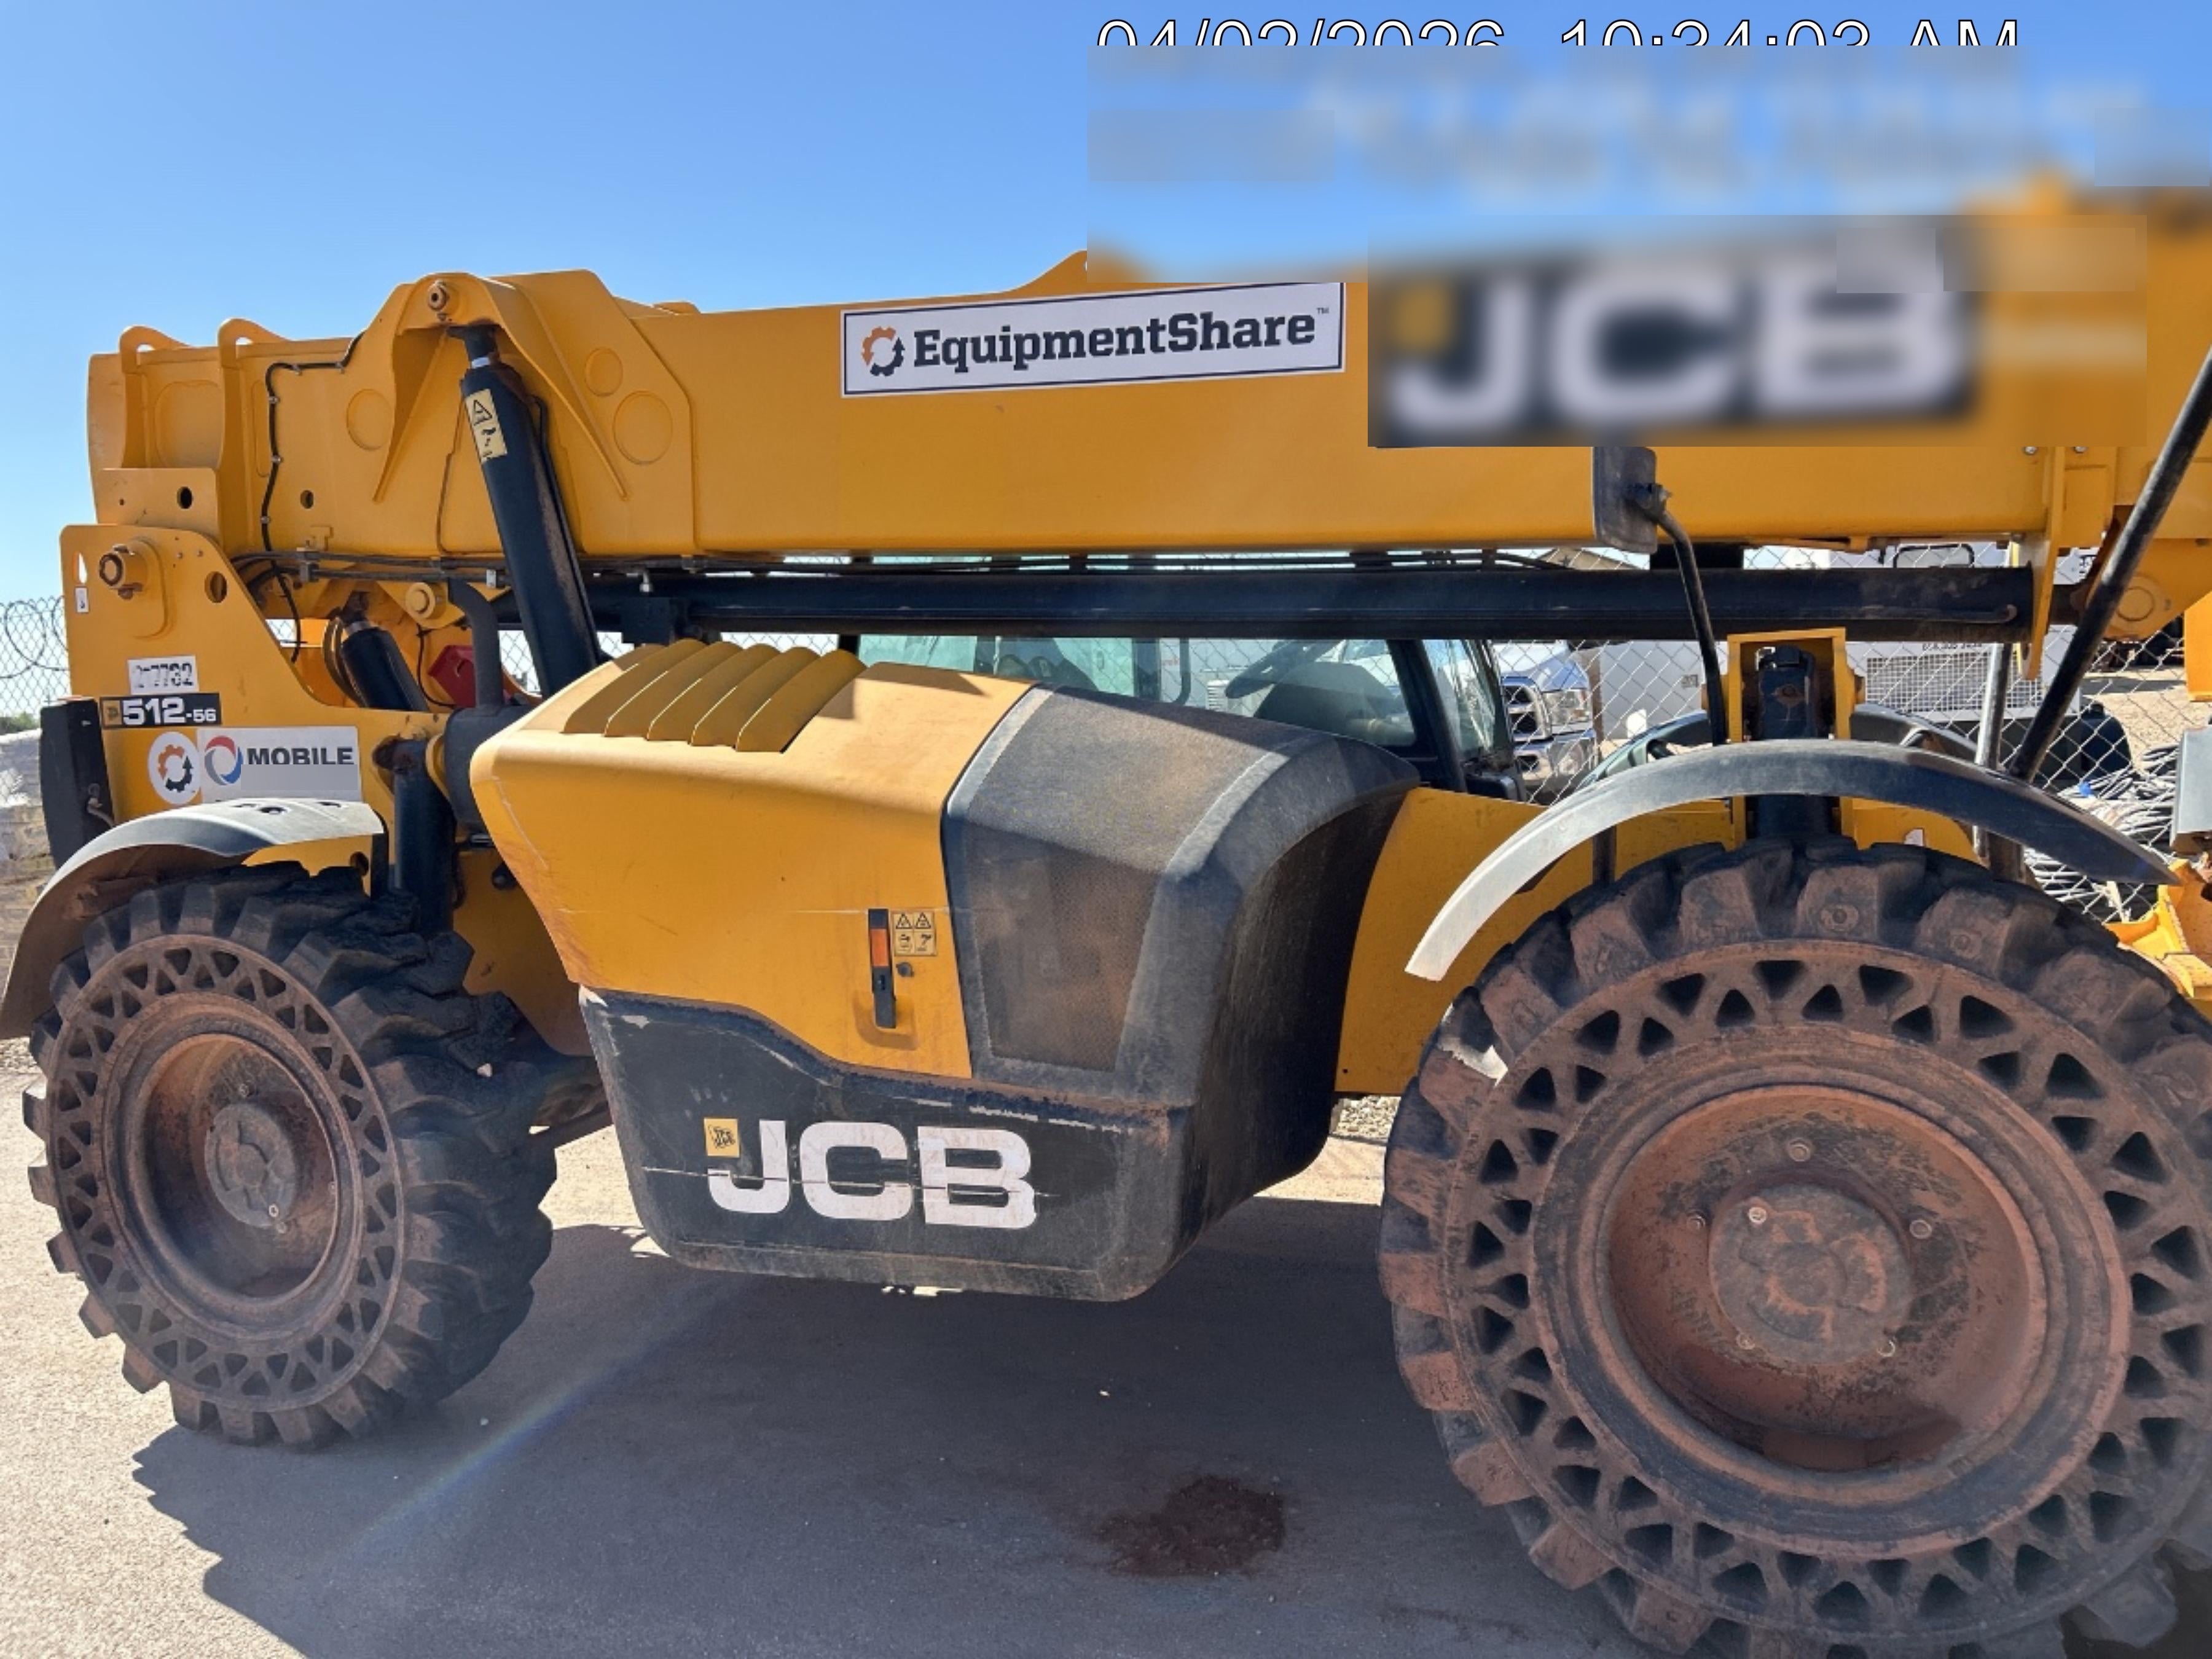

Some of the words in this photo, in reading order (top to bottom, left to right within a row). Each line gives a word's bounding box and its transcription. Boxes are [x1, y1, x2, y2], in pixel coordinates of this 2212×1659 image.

[914, 312, 1315, 372] EquipmentShare
[1390, 246, 1961, 428] JCB
[122, 697, 217, 725] 512-56
[247, 747, 355, 765] MOBILE
[707, 1119, 1037, 1228] JCB
